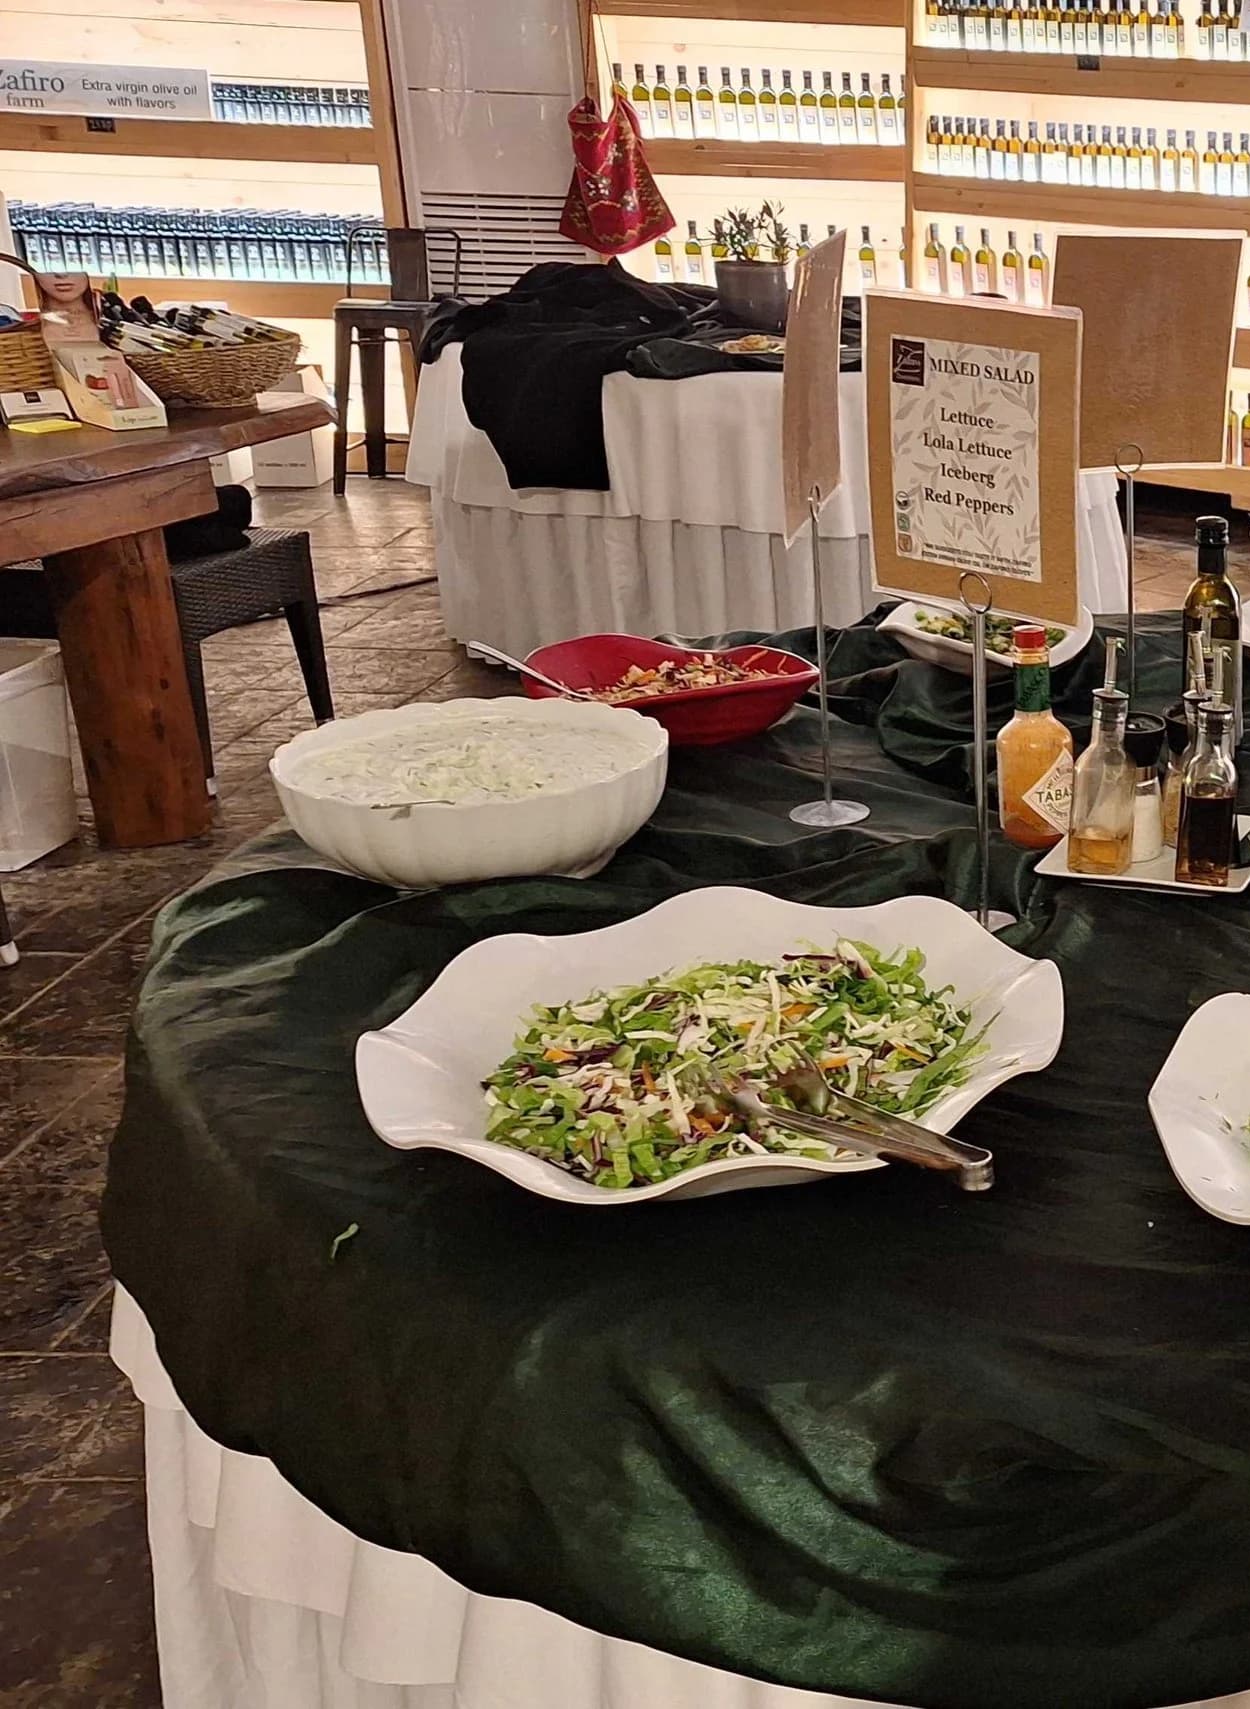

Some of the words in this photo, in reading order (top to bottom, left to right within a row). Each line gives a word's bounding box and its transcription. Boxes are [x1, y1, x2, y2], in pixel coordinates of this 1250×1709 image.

[82, 79, 112, 92] Extra
[116, 81, 149, 95] virgin
[152, 84, 180, 95] olive
[183, 85, 198, 95] oil
[6, 92, 45, 108] farm
[107, 96, 133, 108] with
[136, 98, 177, 110] flavors
[929, 358, 981, 378] MIXED
[983, 365, 1035, 386] SALAD
[940, 407, 995, 429] Lettuce
[923, 432, 954, 451] Lola
[957, 437, 1013, 460] Lettuce
[940, 462, 996, 489] Iceberg
[924, 487, 952, 505] Red
[955, 492, 1015, 516] Peppers
